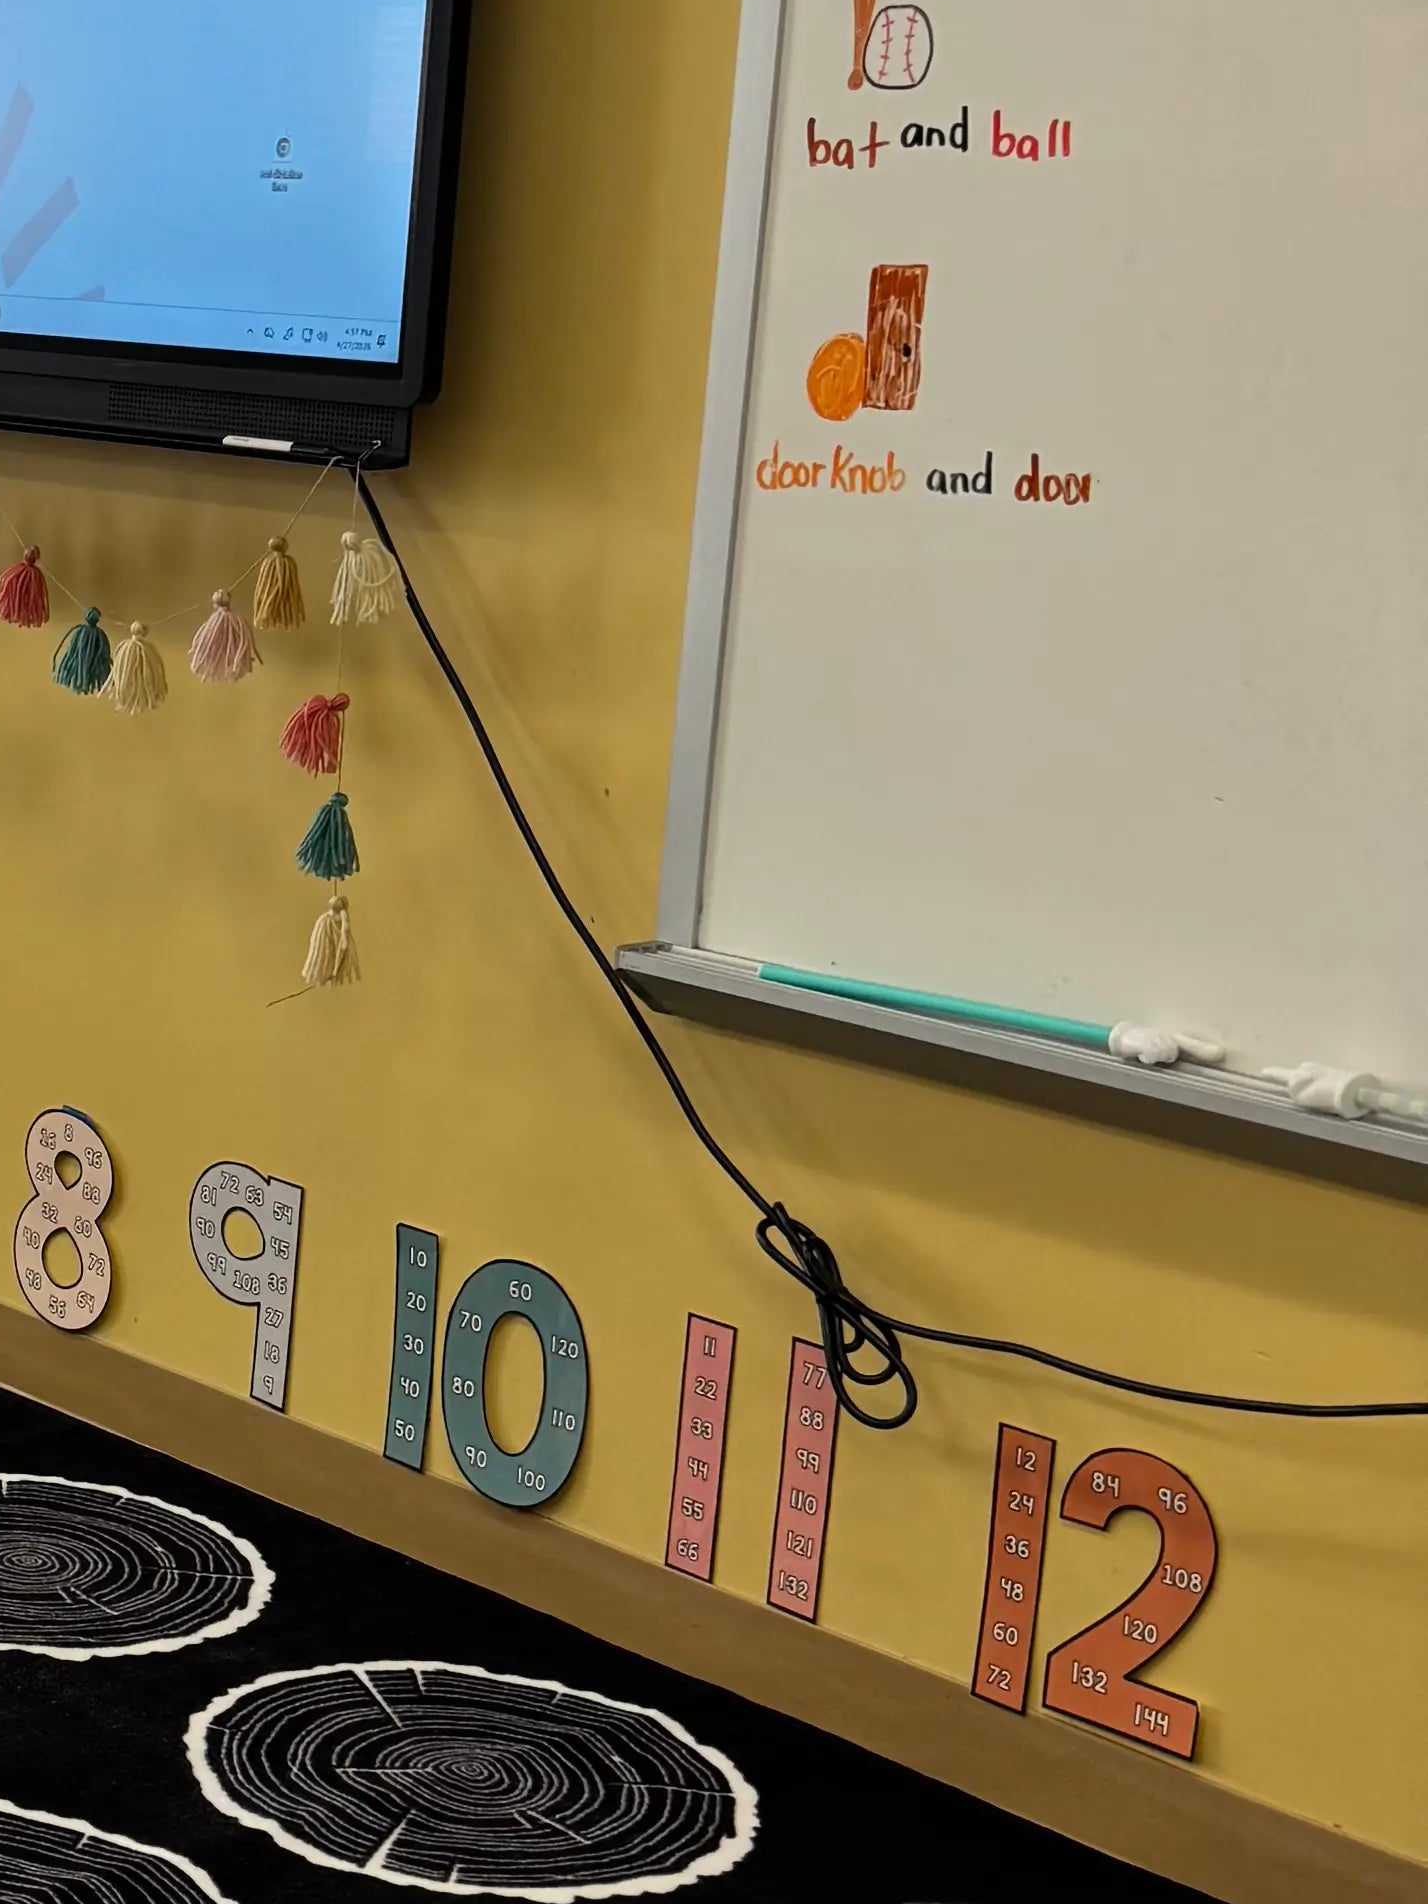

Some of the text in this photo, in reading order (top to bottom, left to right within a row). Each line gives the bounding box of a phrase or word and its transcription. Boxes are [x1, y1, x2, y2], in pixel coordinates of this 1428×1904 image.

[807, 106, 1071, 170] bat and ball
[926, 451, 993, 495] and
[1014, 453, 1091, 505] door
[14, 1108, 114, 1330] 8
[409, 1247, 427, 1268] 10
[190, 1160, 304, 1412] 9
[509, 1280, 532, 1301] 60
[406, 1291, 426, 1312] 20
[460, 1310, 482, 1332] 70
[403, 1334, 424, 1355] 30
[551, 1335, 579, 1359] 120
[704, 1336, 716, 1357] 11
[384, 1223, 590, 1509] 10
[803, 1361, 828, 1389] 77
[400, 1377, 420, 1398] 40
[452, 1376, 474, 1397] 80
[694, 1376, 717, 1400] 22
[394, 1420, 415, 1441] 50
[552, 1409, 576, 1431] 110
[691, 1417, 713, 1440] 33
[800, 1406, 824, 1431] 88
[465, 1446, 487, 1468] 90
[665, 1312, 842, 1625] 11
[688, 1456, 709, 1480] 44
[796, 1448, 820, 1474] 99
[1016, 1448, 1036, 1471] 12
[517, 1467, 545, 1491] 100
[1092, 1472, 1120, 1498] 84
[682, 1497, 703, 1521] 55
[790, 1489, 817, 1515] 110
[1009, 1491, 1034, 1515] 24
[1158, 1487, 1188, 1514] 96
[677, 1539, 699, 1561] 66
[787, 1530, 813, 1559] 121
[1005, 1535, 1029, 1559] 36
[779, 1571, 809, 1601] 132
[971, 1422, 1218, 1760] 12
[1000, 1577, 1024, 1602] 48
[1162, 1565, 1202, 1594] 108
[993, 1622, 1018, 1646] 60
[1124, 1616, 1158, 1645] 120
[987, 1664, 1012, 1691] 72
[1072, 1661, 1108, 1694] 132
[1134, 1704, 1169, 1736] 144
